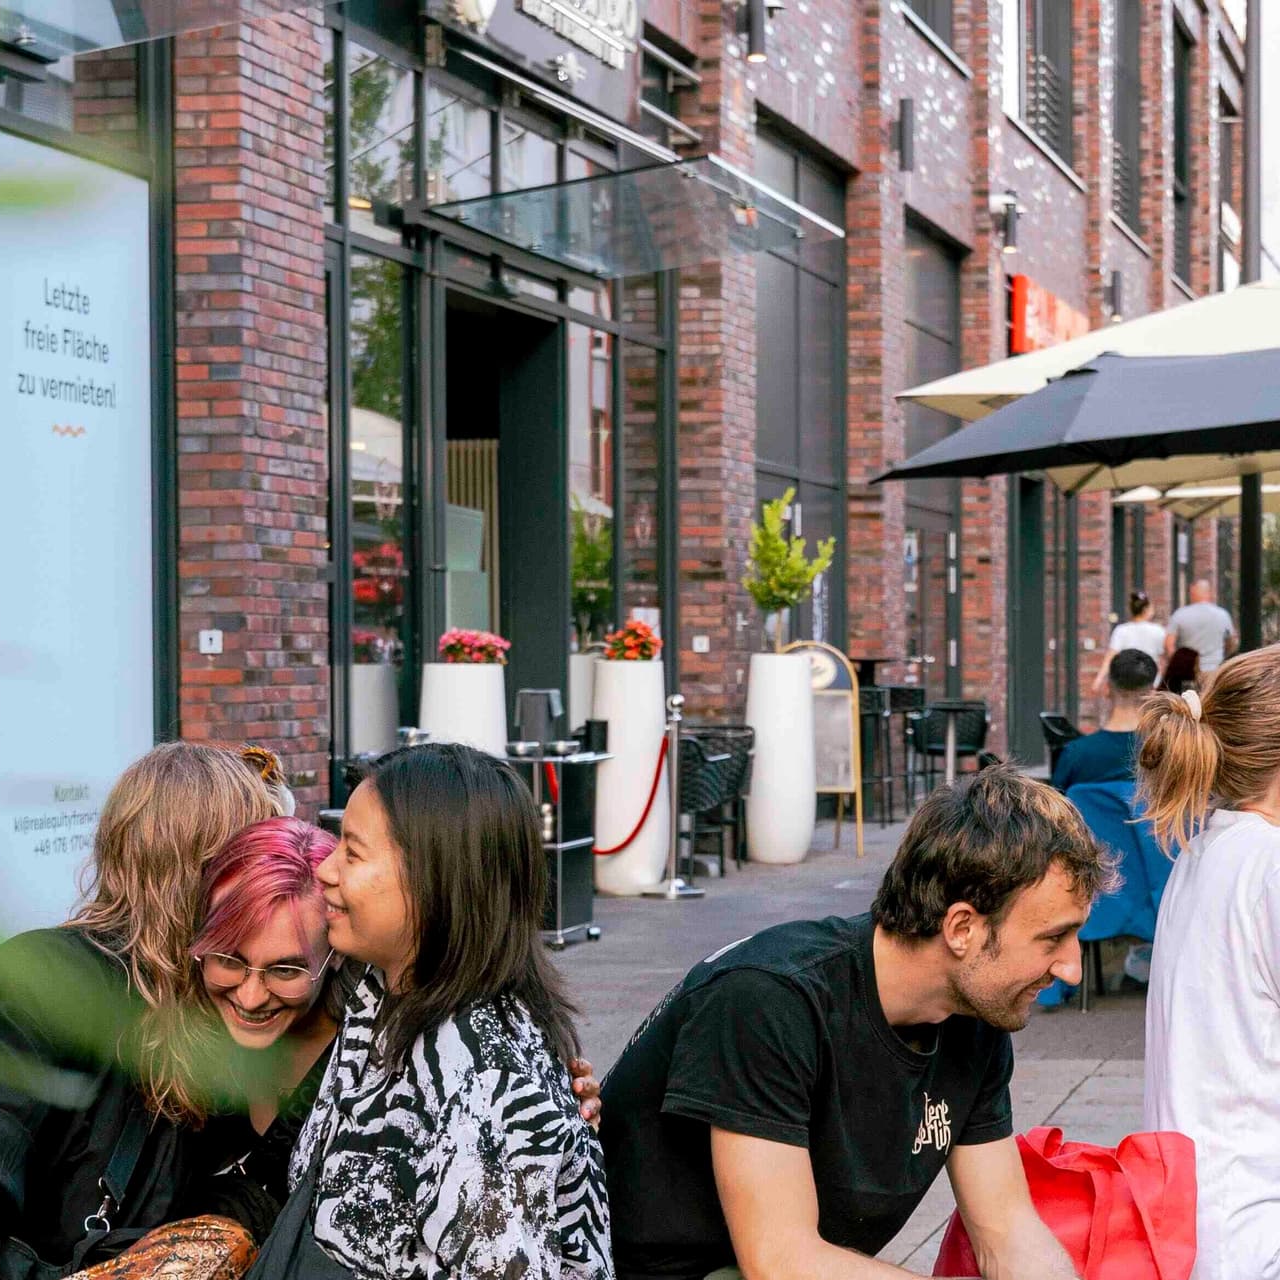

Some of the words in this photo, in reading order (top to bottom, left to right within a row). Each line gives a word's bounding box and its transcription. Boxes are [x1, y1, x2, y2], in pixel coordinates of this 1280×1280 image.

[43, 277, 90, 315] Letzte
[24, 320, 58, 354] freie
[63, 328, 109, 364] Fläche
[18, 373, 35, 396] zu
[41, 376, 116, 409] vermieten!
